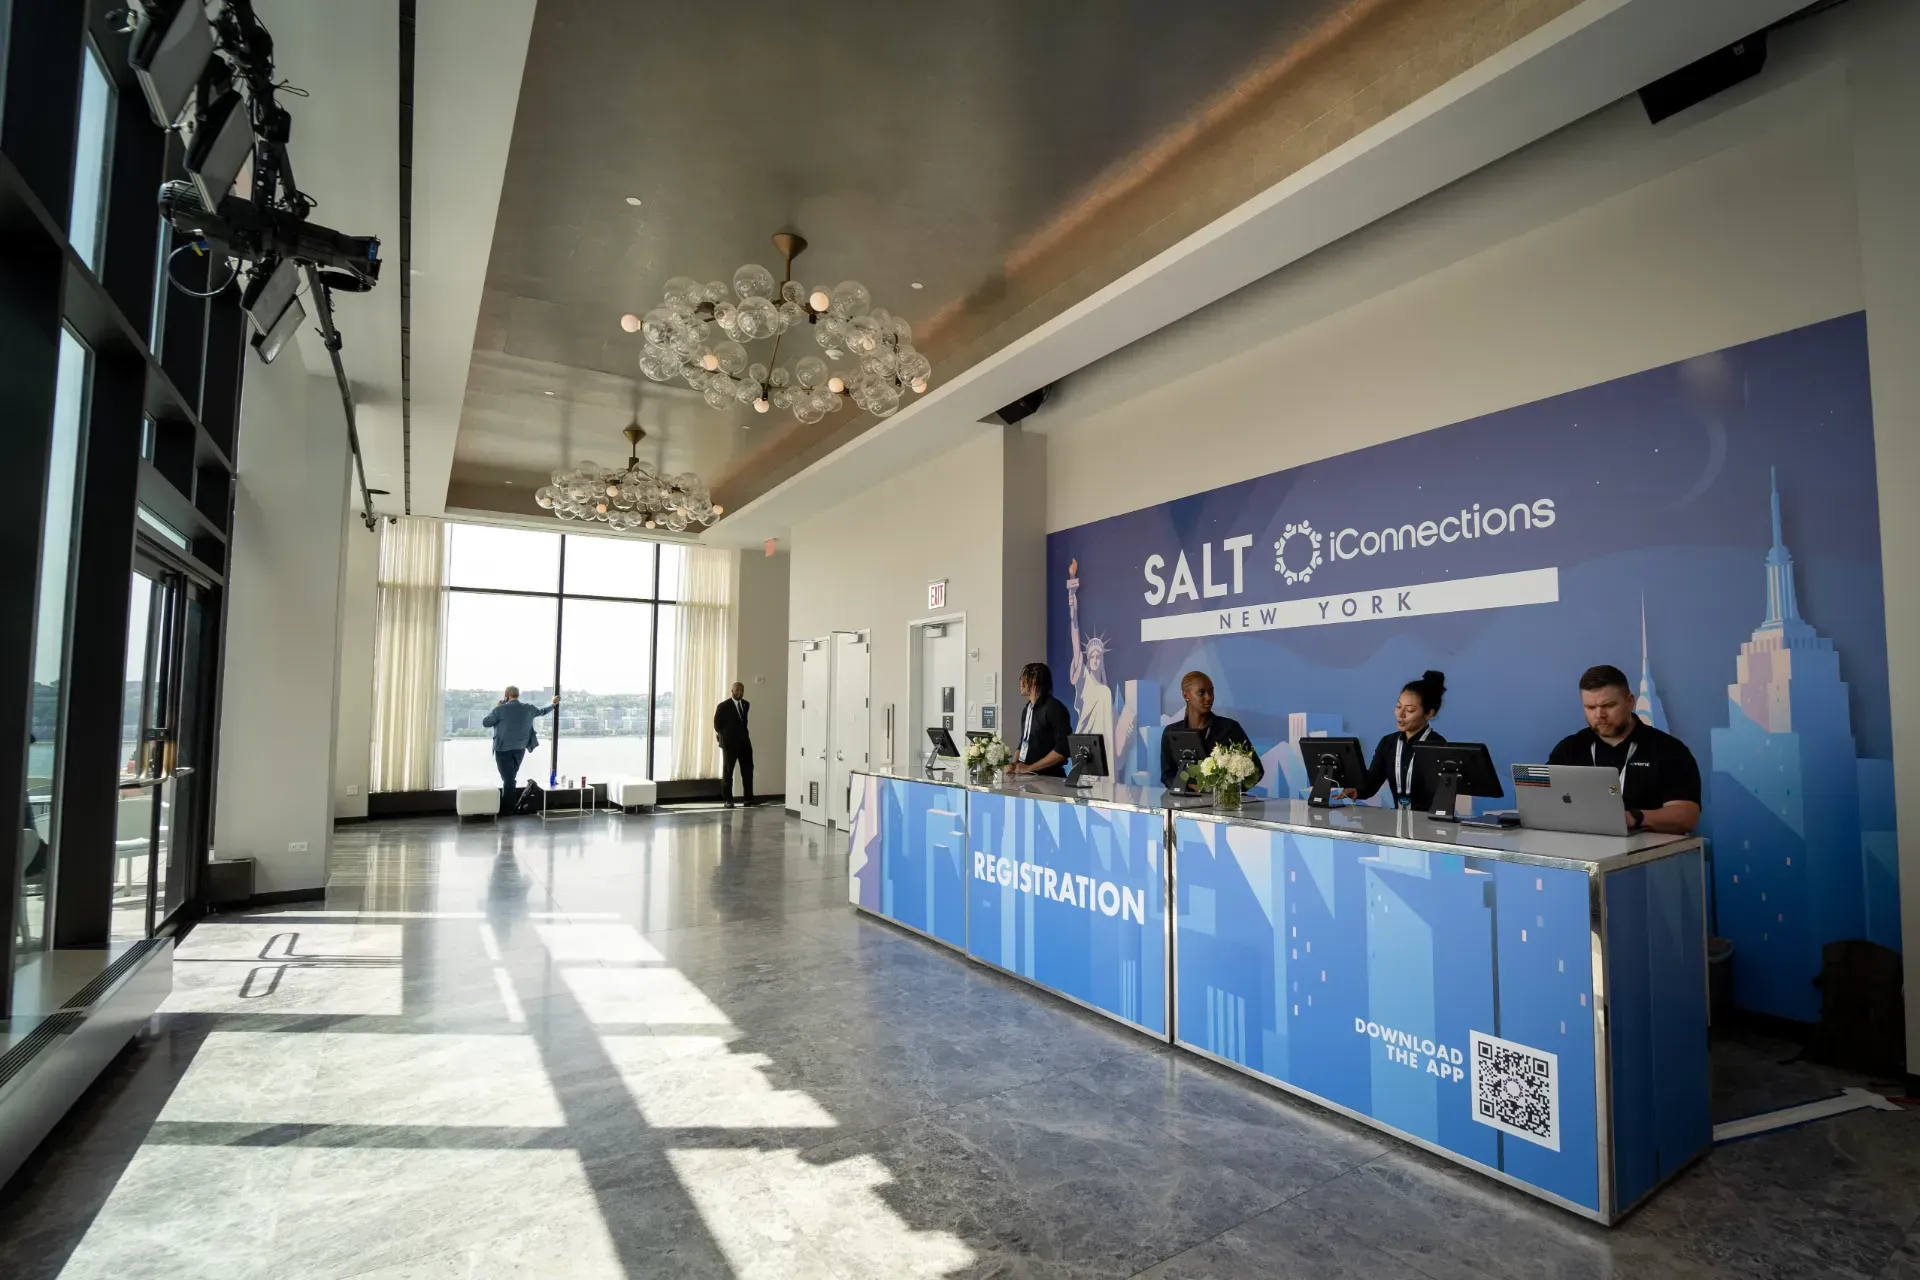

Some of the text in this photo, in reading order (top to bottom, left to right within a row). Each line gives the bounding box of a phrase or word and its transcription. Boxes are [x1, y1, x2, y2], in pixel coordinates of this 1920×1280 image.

[1329, 498, 1556, 562] iConnections
[1143, 533, 1253, 606] SALT
[930, 584, 944, 607] EXIT
[1219, 591, 1413, 630] NEW YORK
[974, 850, 1145, 926] REGISTRATION
[1355, 1017, 1464, 1066] DOWNLOAD
[1386, 1044, 1465, 1083] THE APP
